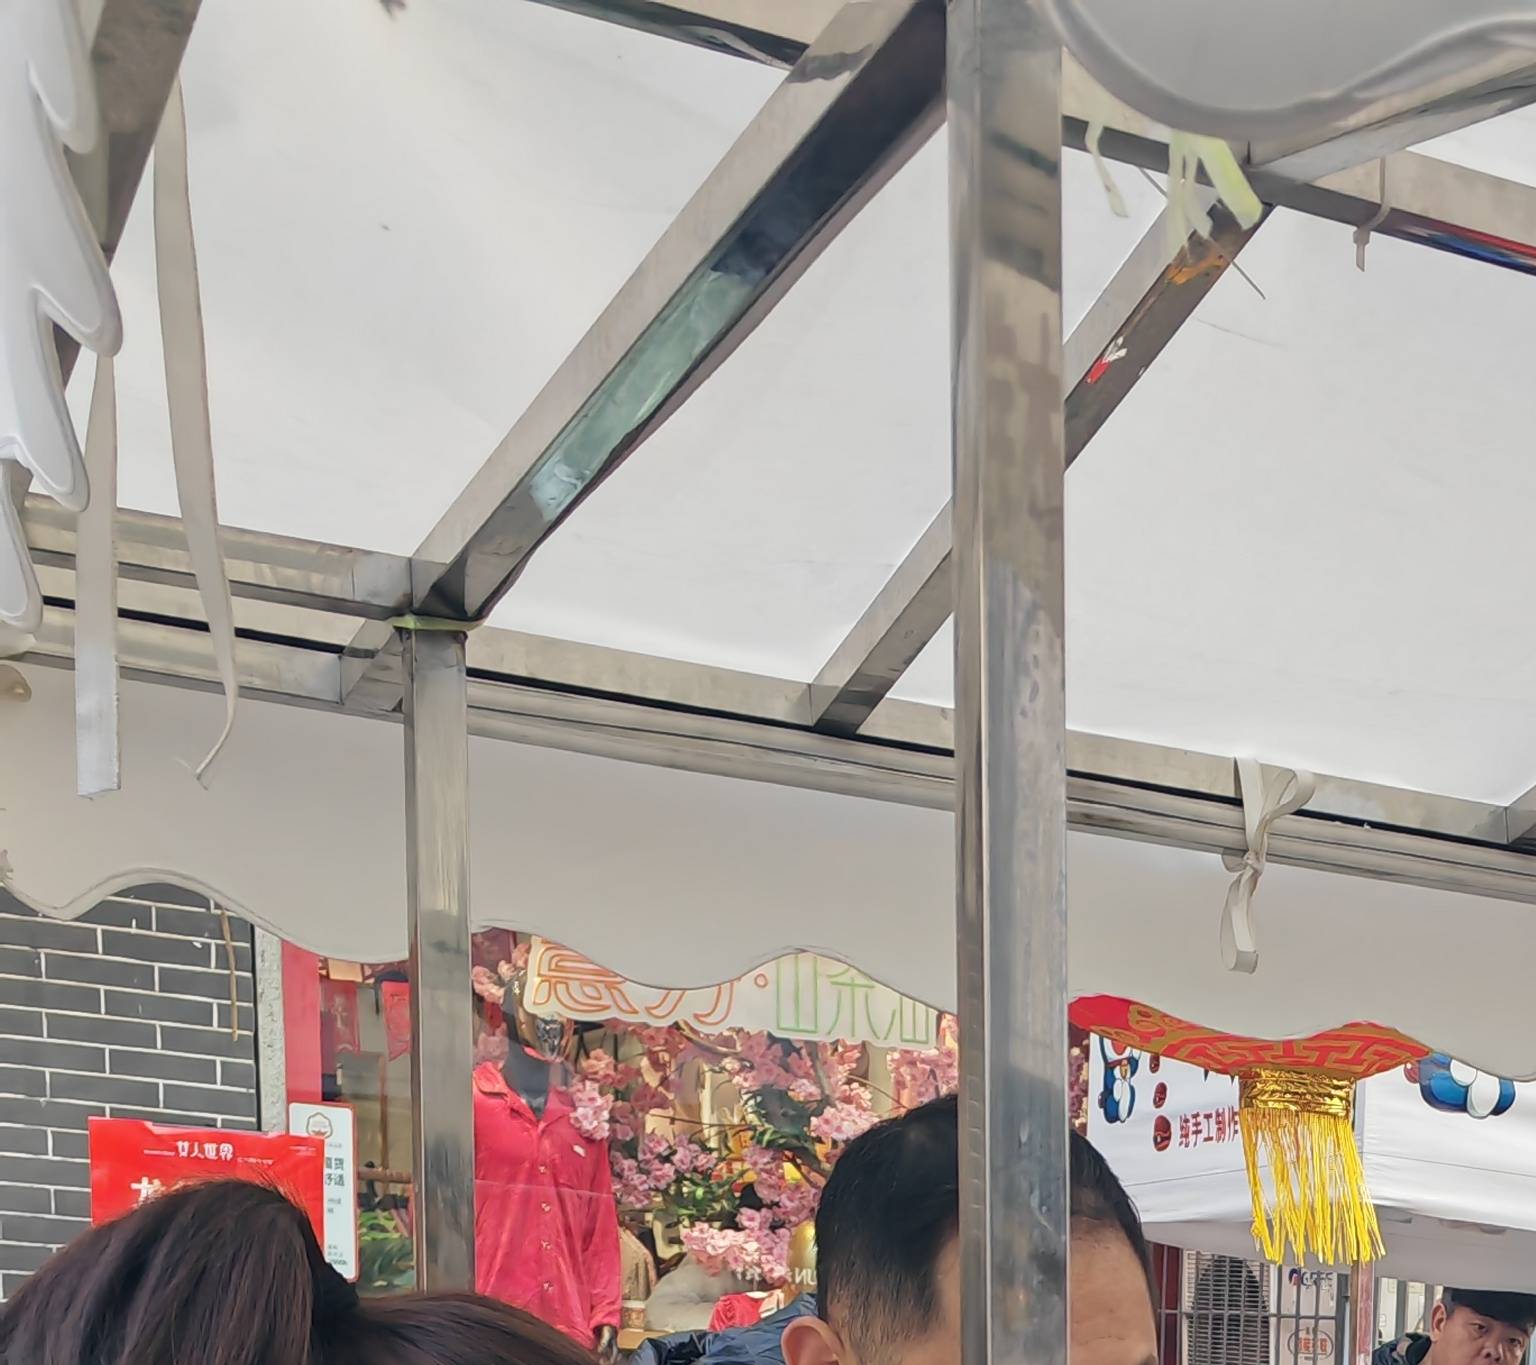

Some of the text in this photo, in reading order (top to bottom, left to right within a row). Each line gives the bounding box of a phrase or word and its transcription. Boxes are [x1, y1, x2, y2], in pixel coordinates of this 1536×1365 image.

[1178, 1105, 1241, 1148] 纯手工制作
